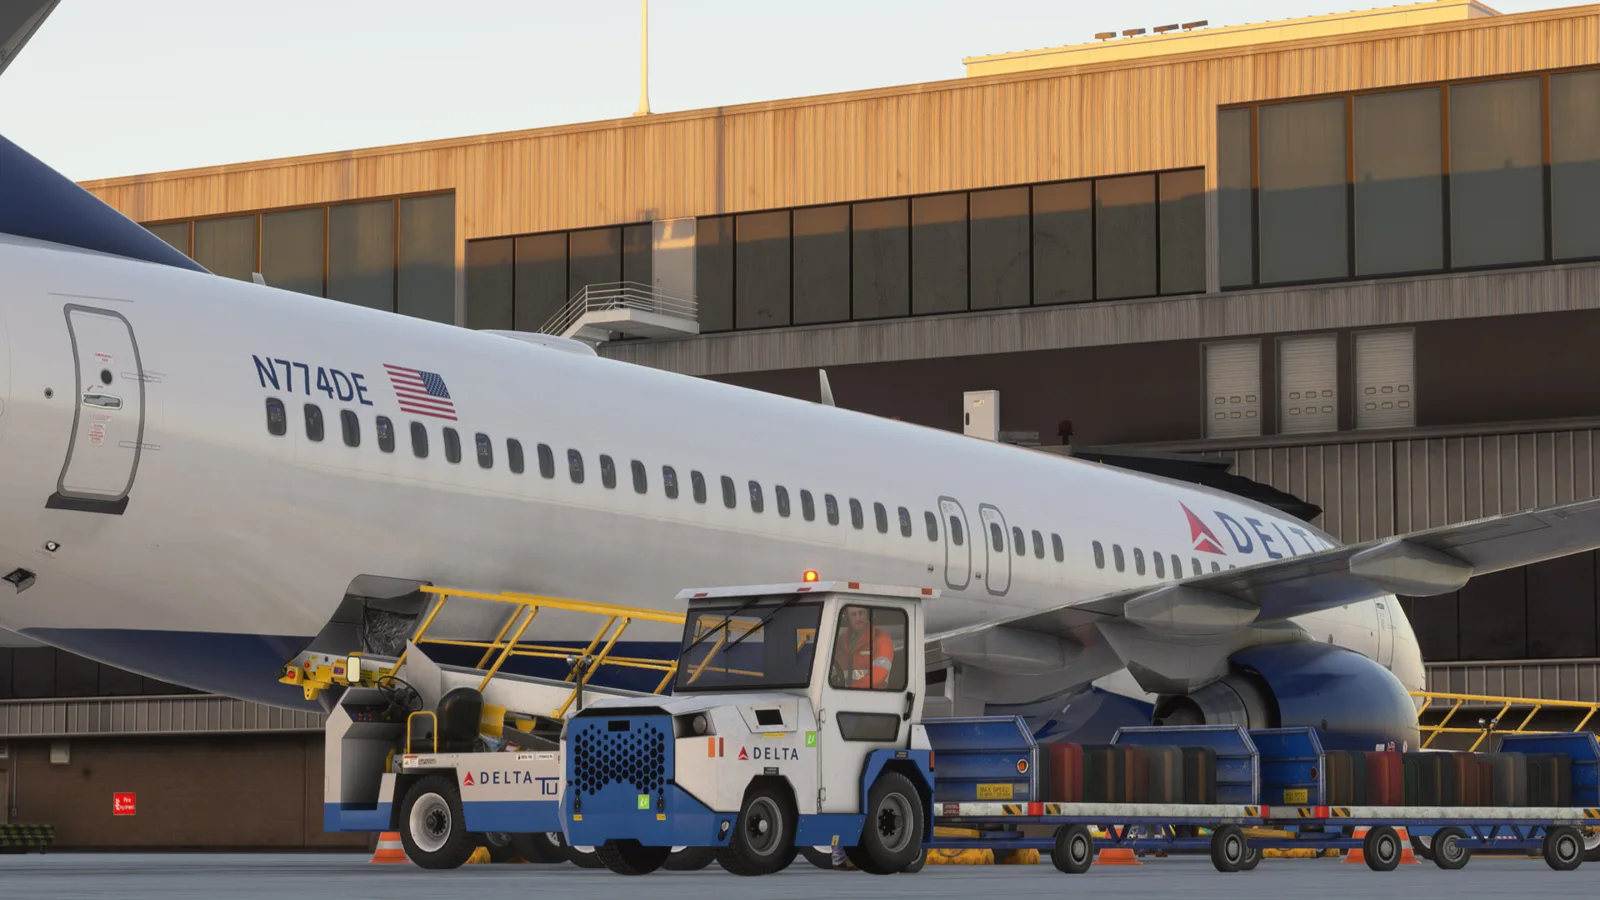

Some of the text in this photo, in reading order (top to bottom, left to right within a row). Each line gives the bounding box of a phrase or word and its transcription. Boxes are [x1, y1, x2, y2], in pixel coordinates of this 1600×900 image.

[252, 354, 373, 406] N774DE
[753, 746, 799, 761] DELTA
[480, 771, 533, 785] DELTA
